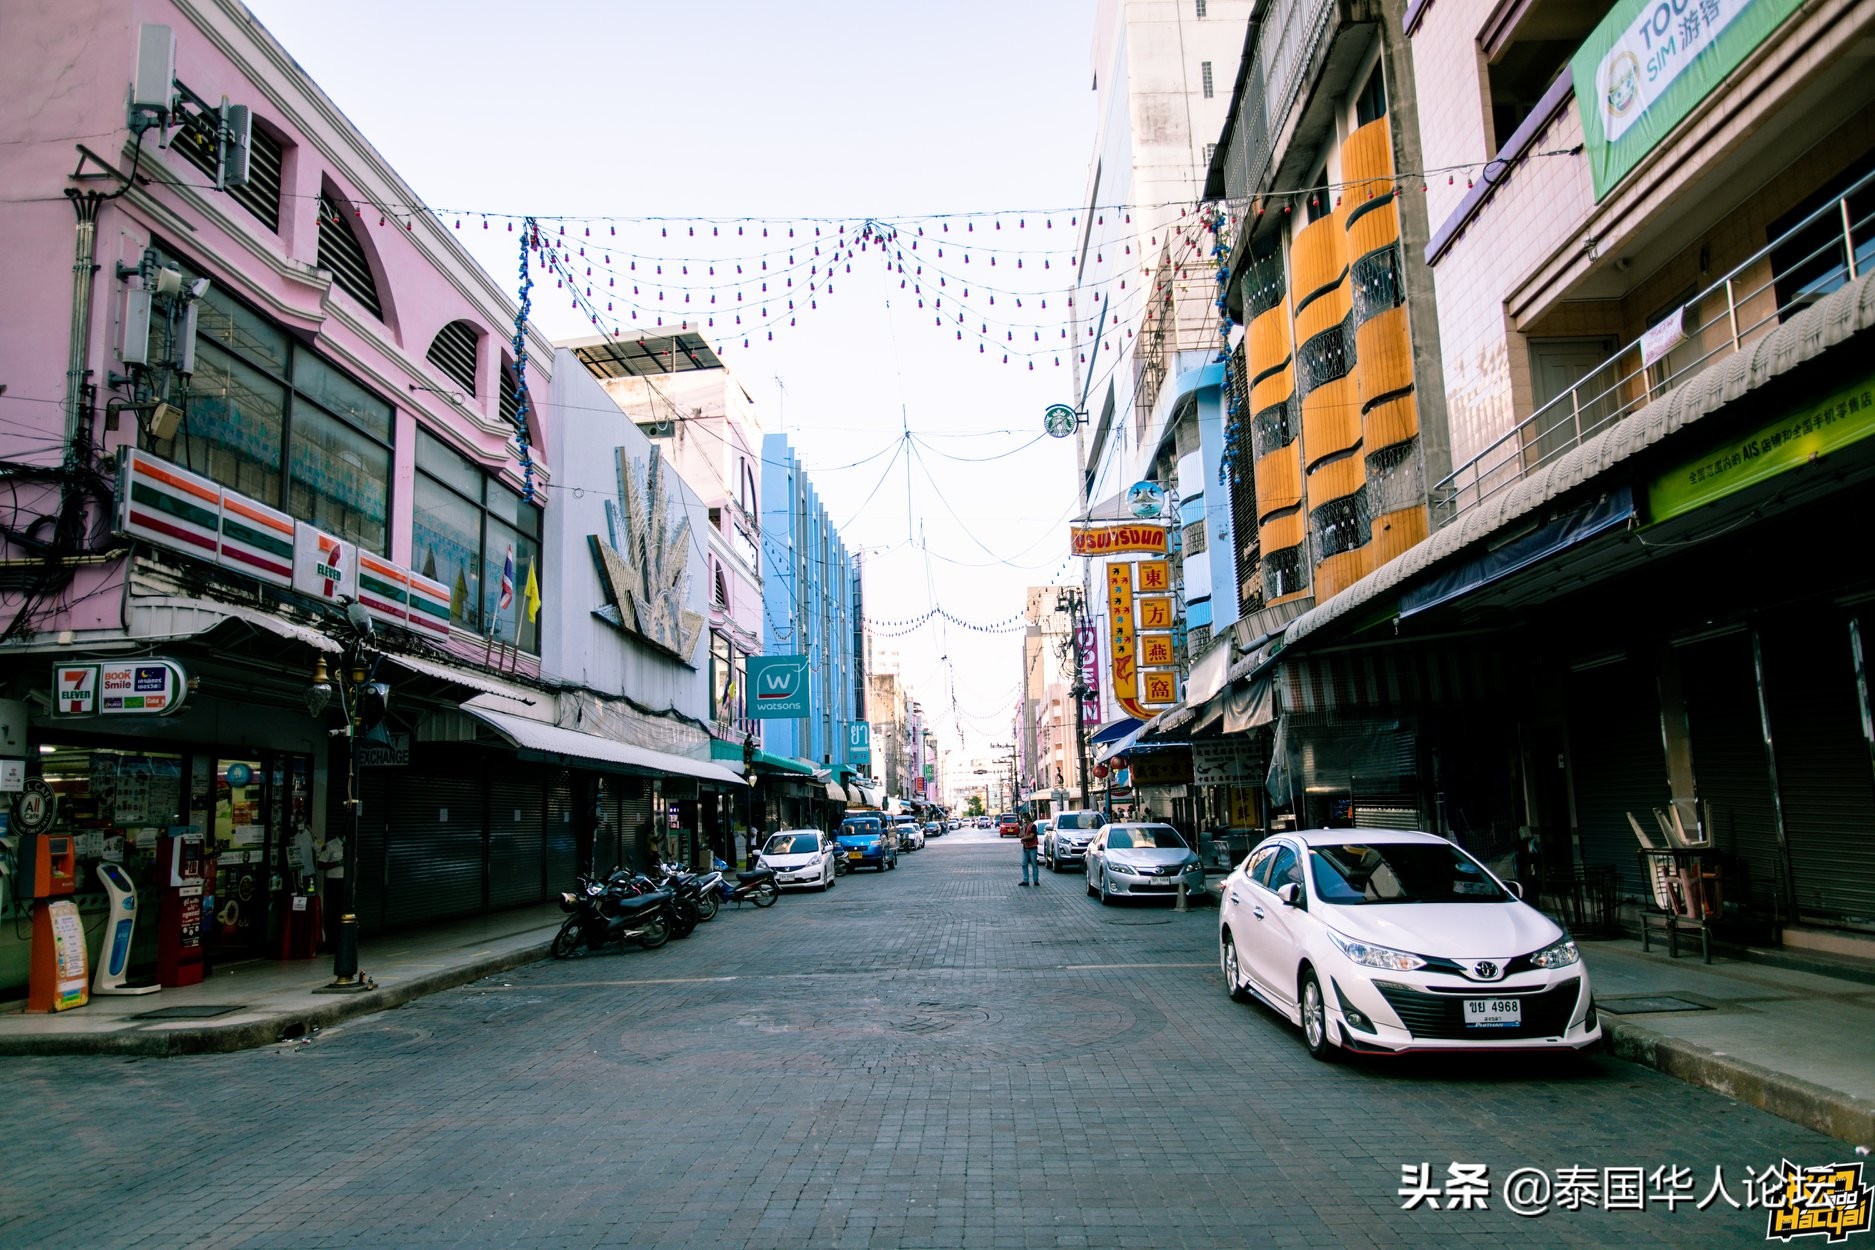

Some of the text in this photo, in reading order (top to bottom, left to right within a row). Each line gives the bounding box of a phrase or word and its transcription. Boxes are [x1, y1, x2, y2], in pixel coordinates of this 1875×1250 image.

[1647, 35, 1676, 82] SIM
[1742, 441, 1761, 462] AIS
[318, 534, 341, 598] 7
[1145, 569, 1169, 698] 東方燕窩
[104, 672, 131, 680] BOOK
[104, 681, 132, 690] Smile
[64, 670, 88, 713] 7
[756, 702, 801, 710] watsons
[850, 725, 868, 744] ยา
[359, 748, 408, 764] EXCHANGE
[1491, 1001, 1518, 1012] 4968
